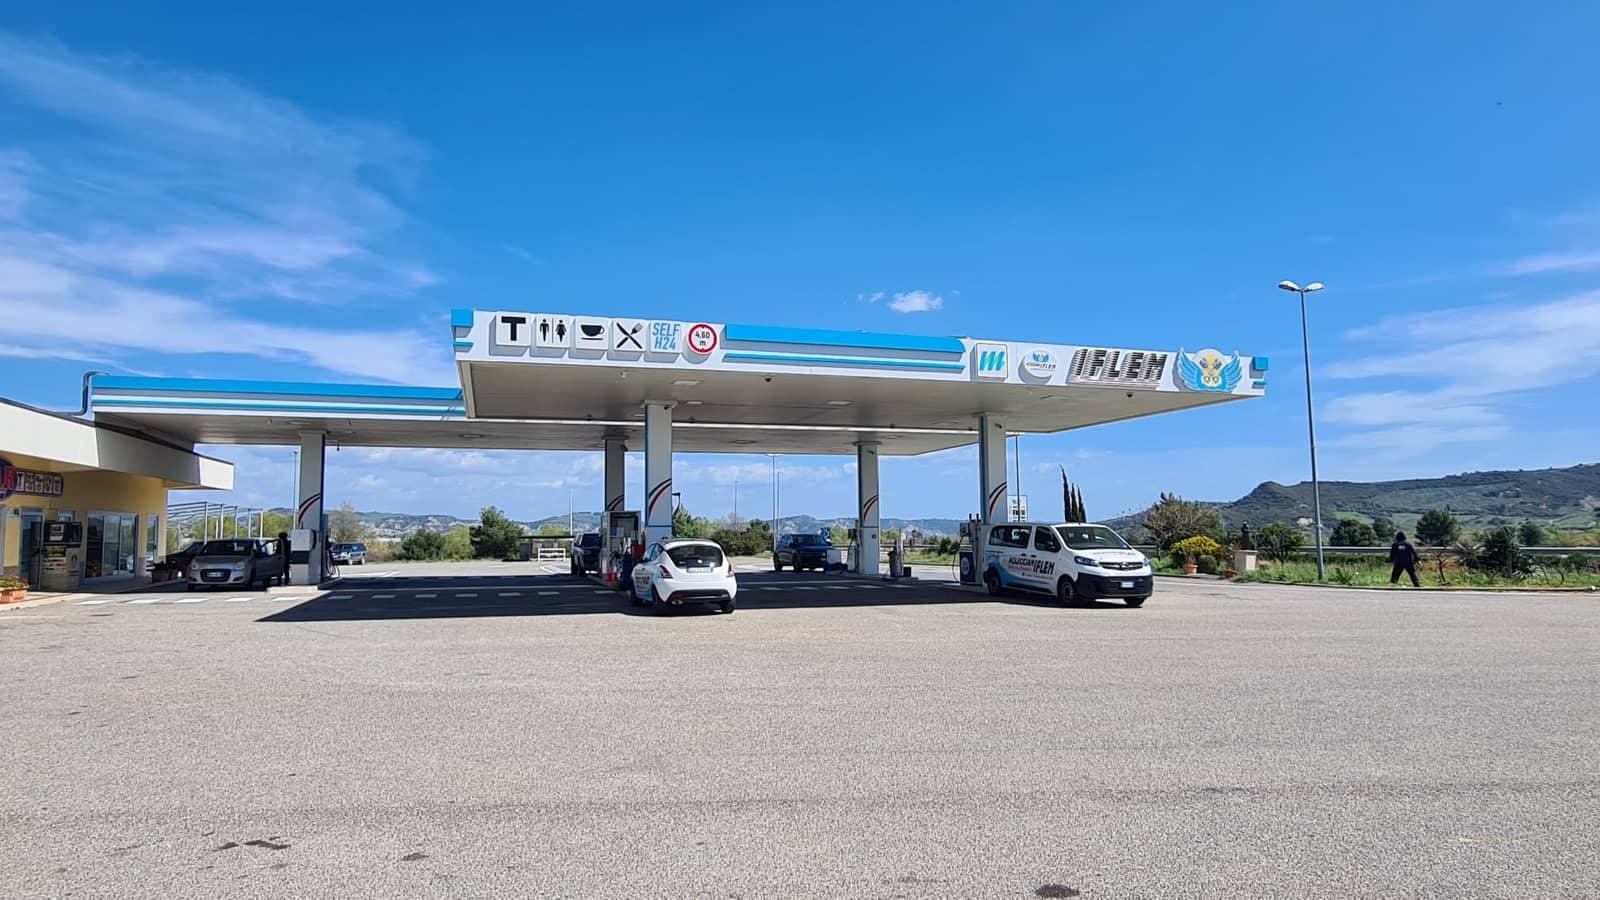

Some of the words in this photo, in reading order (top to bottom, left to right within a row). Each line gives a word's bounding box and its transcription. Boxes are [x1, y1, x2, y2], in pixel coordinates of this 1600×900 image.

[501, 316, 526, 341] T
[652, 322, 680, 337] SELF
[654, 336, 676, 350] H24
[1072, 349, 1168, 381] IFLEM
[1033, 560, 1055, 575] IFLEM
